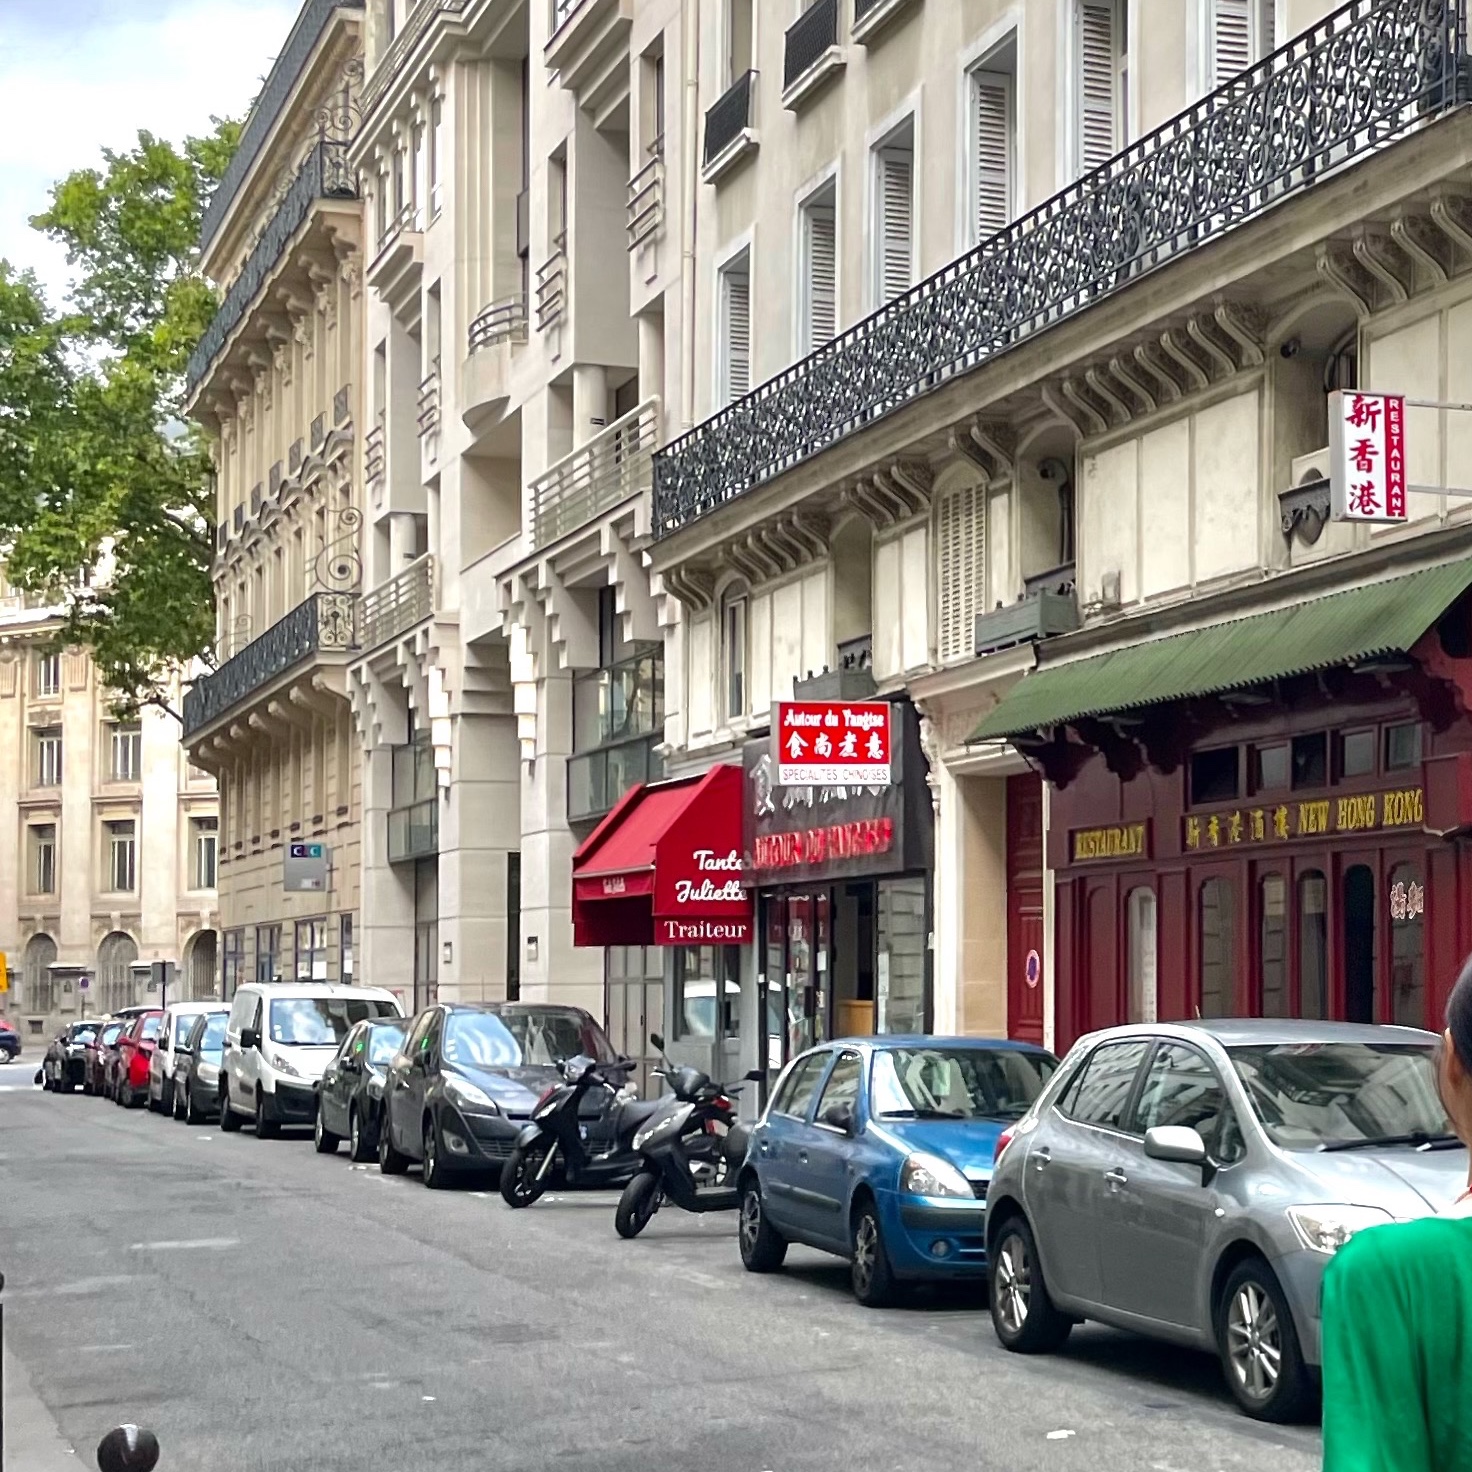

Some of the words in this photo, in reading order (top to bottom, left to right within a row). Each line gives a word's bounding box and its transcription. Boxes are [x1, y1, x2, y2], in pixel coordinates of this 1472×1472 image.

[1345, 394, 1383, 516] 新香港
[1389, 398, 1402, 518] RESTAURANT
[784, 708, 823, 727] Autour
[825, 708, 839, 727] du
[1298, 800, 1330, 834] NEW
[1337, 794, 1375, 829] HONG
[1383, 788, 1423, 826] KONG
[675, 878, 747, 903] Juliette
[664, 920, 747, 939] Traiteur
